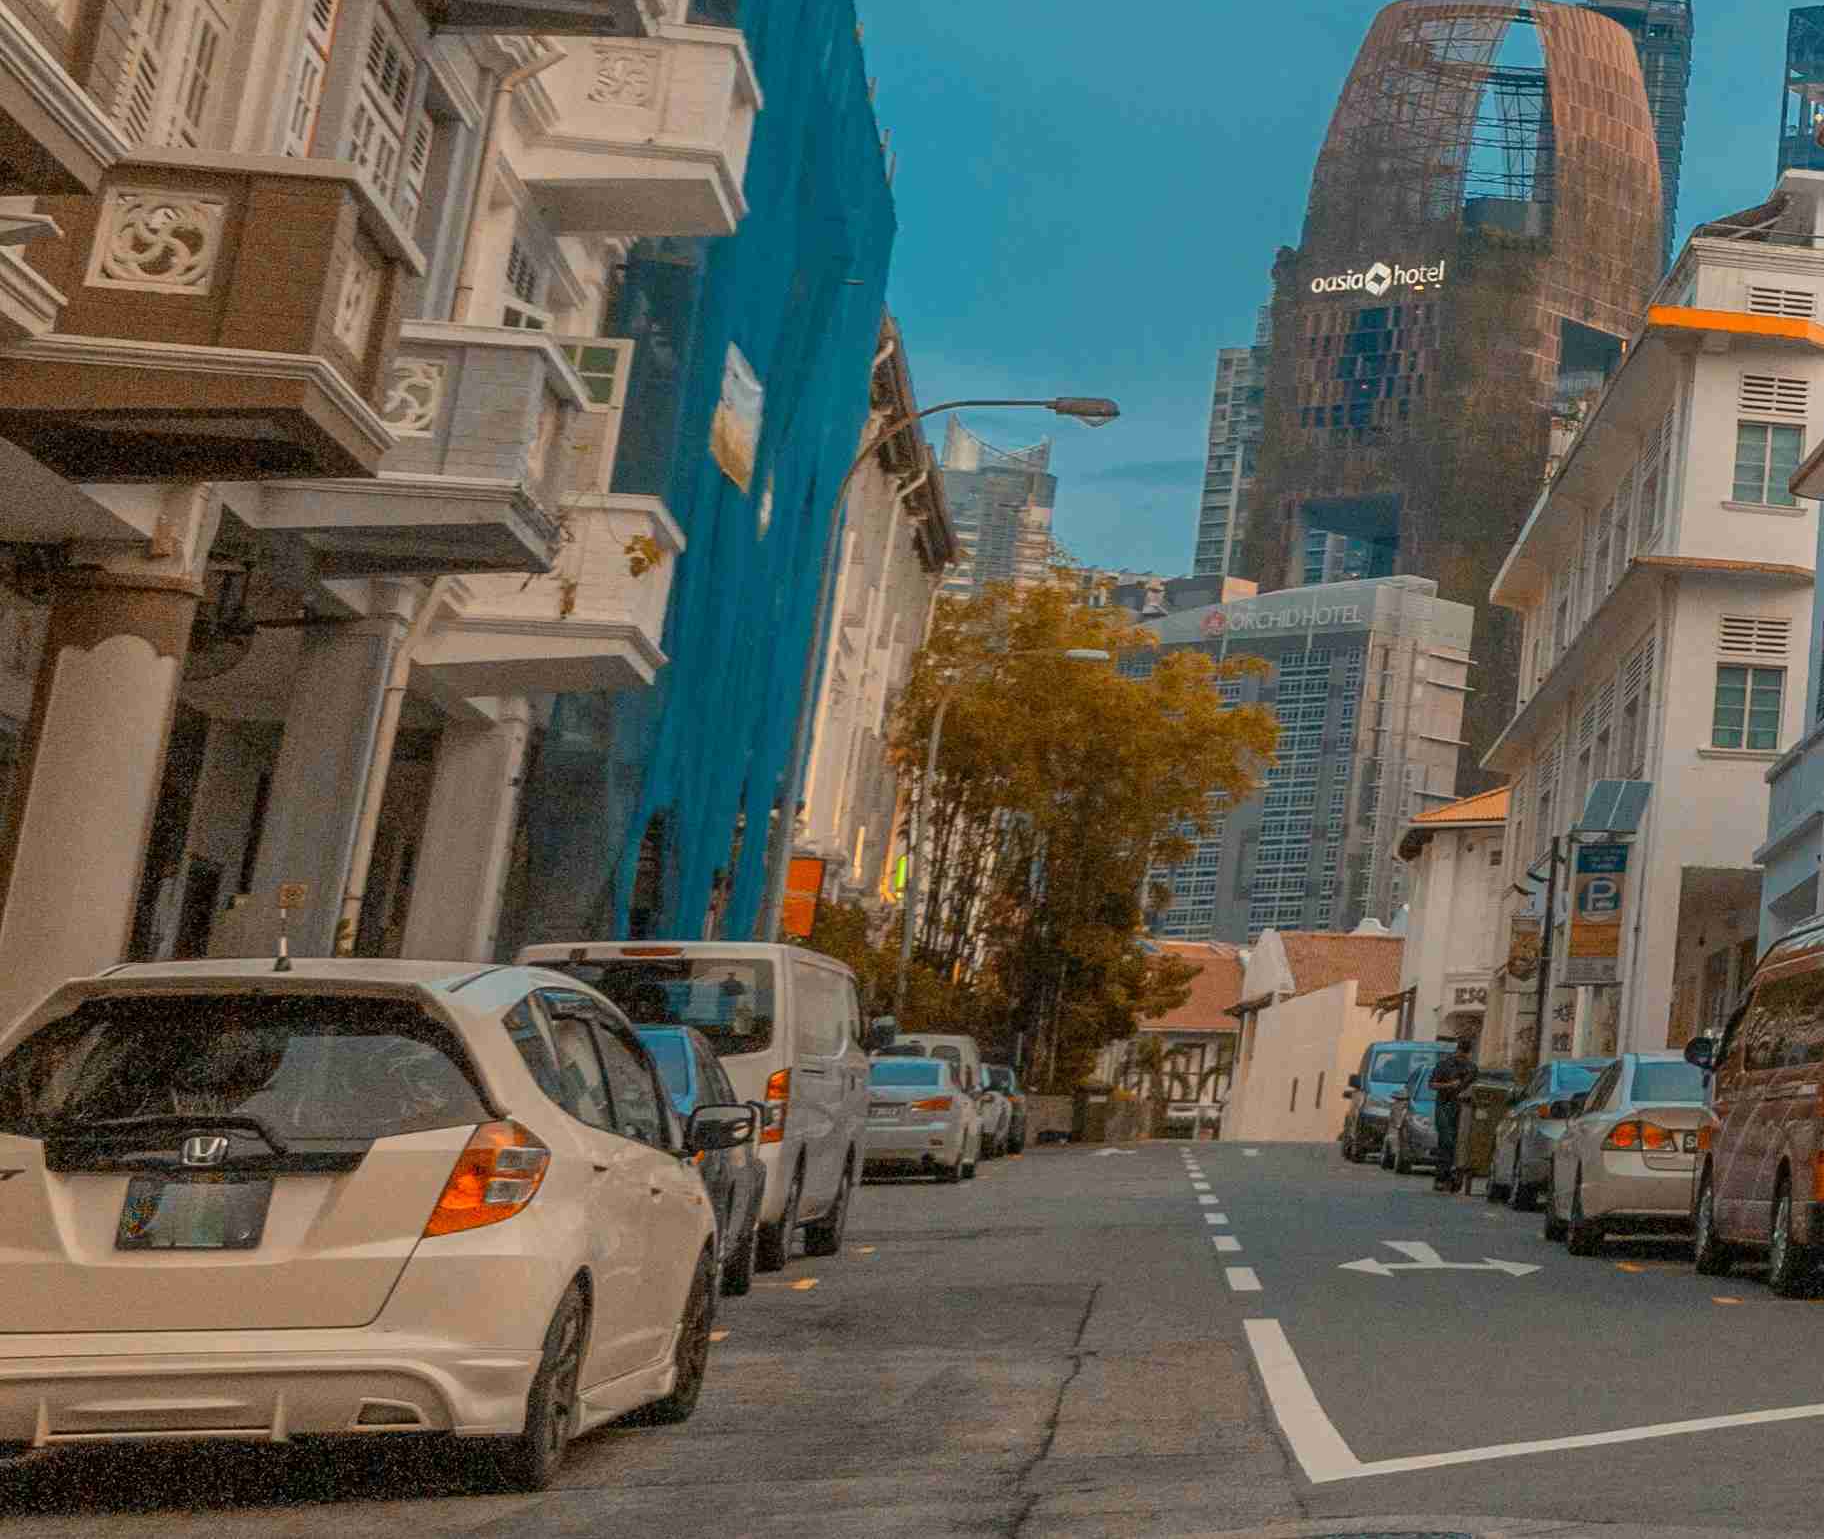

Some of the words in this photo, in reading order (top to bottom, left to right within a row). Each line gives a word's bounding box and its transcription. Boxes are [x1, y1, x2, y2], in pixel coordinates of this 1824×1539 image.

[1311, 269, 1363, 294] oasia
[1393, 260, 1446, 286] hotel
[1230, 609, 1300, 631] ORCHID
[1301, 604, 1362, 627] HOTEL
